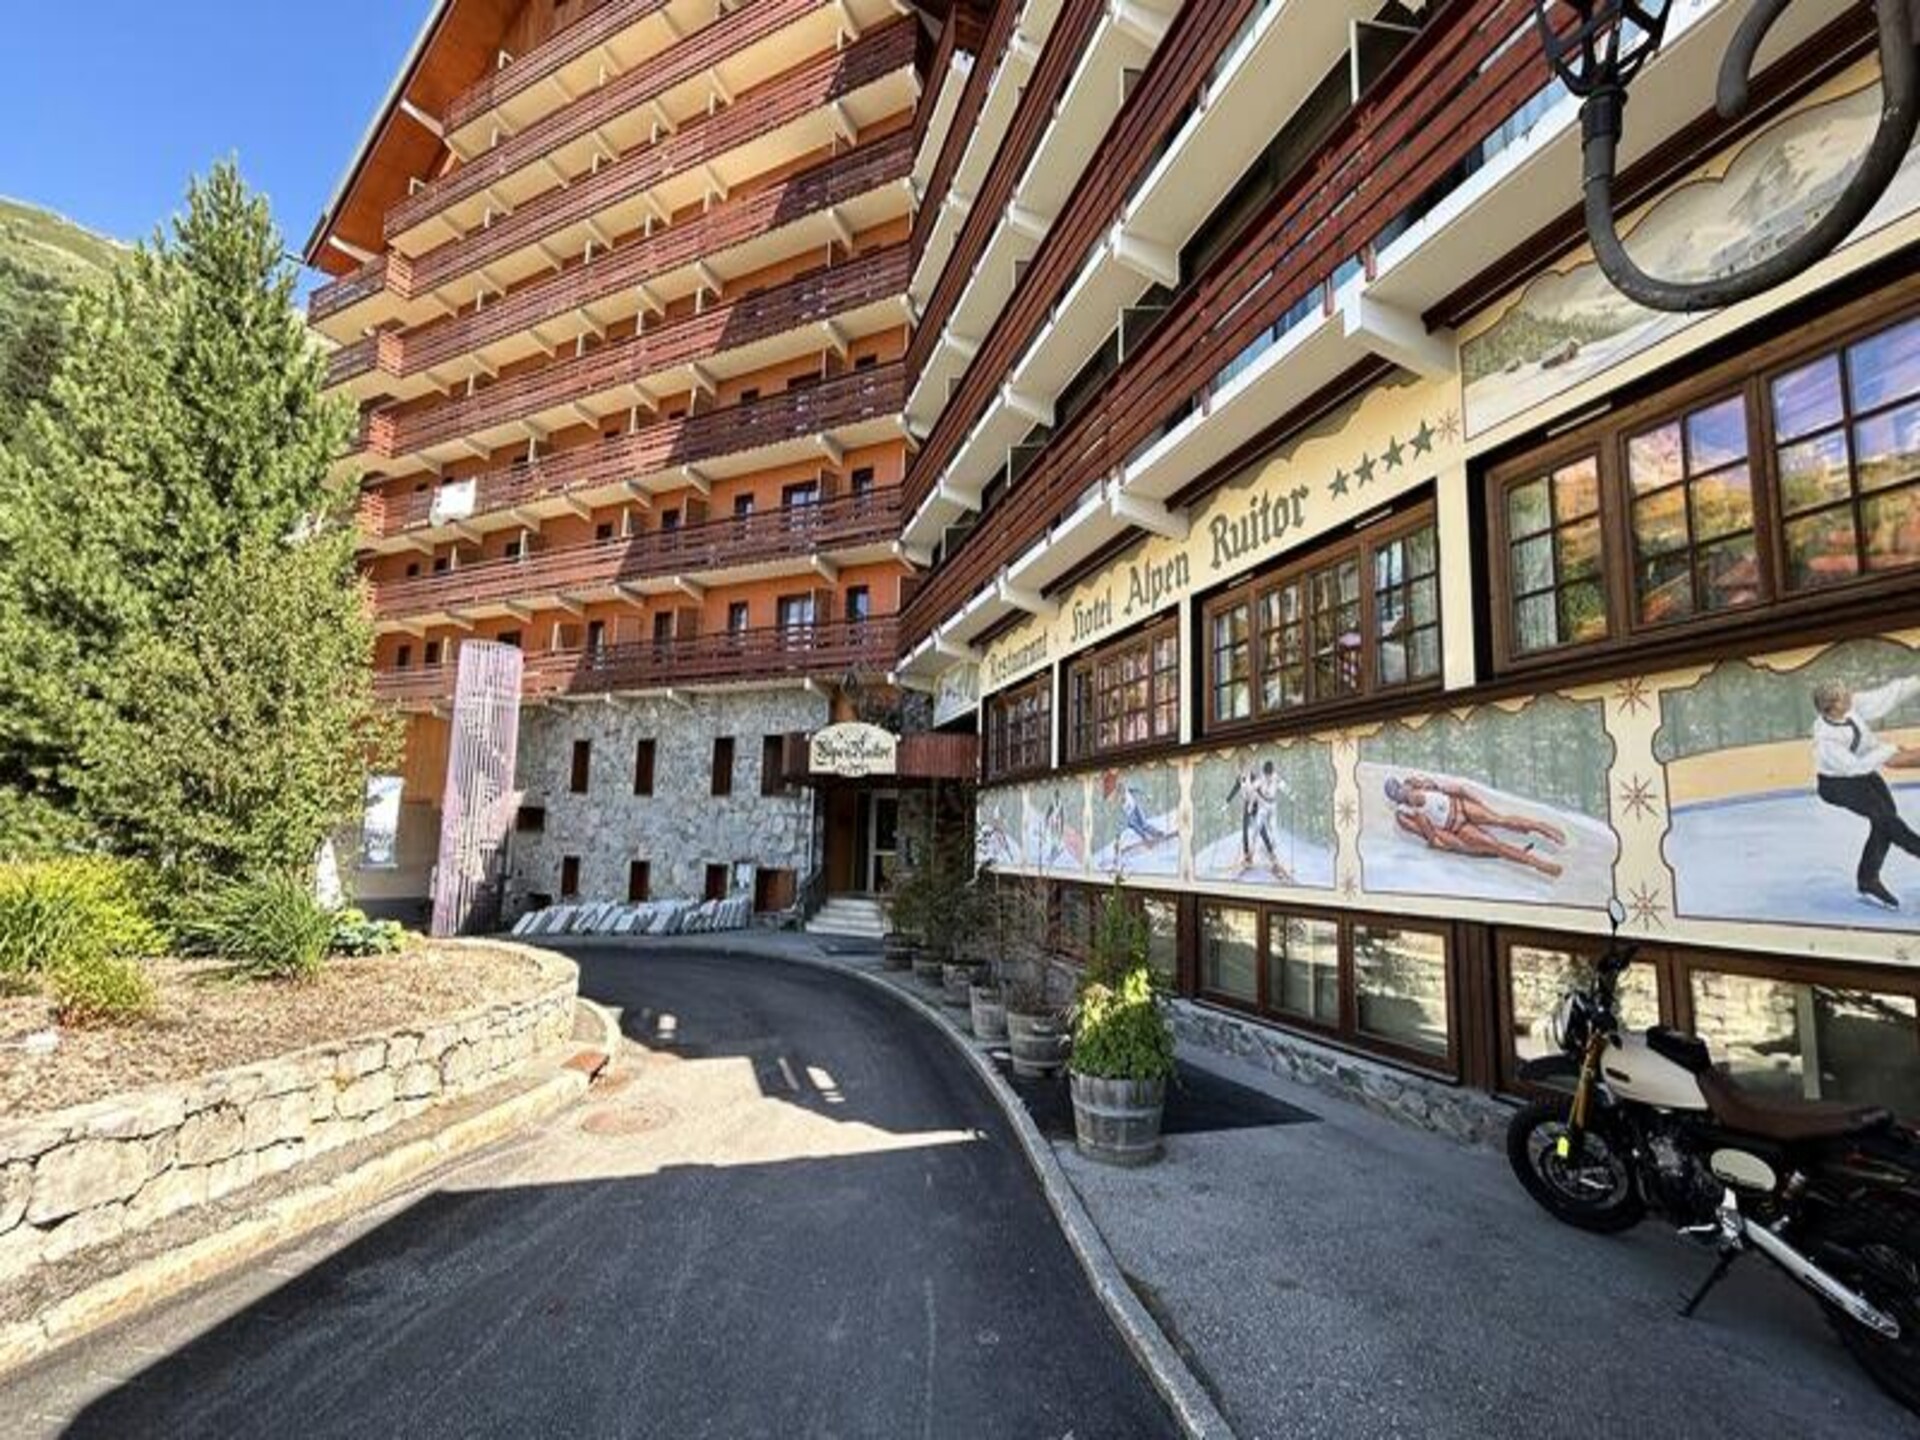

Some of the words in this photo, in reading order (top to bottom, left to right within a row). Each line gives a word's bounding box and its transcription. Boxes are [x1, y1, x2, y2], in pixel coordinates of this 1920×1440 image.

[1071, 586, 1112, 643] Hotel
[1124, 552, 1190, 614] Alpen
[1208, 485, 1309, 570] Ruitor
